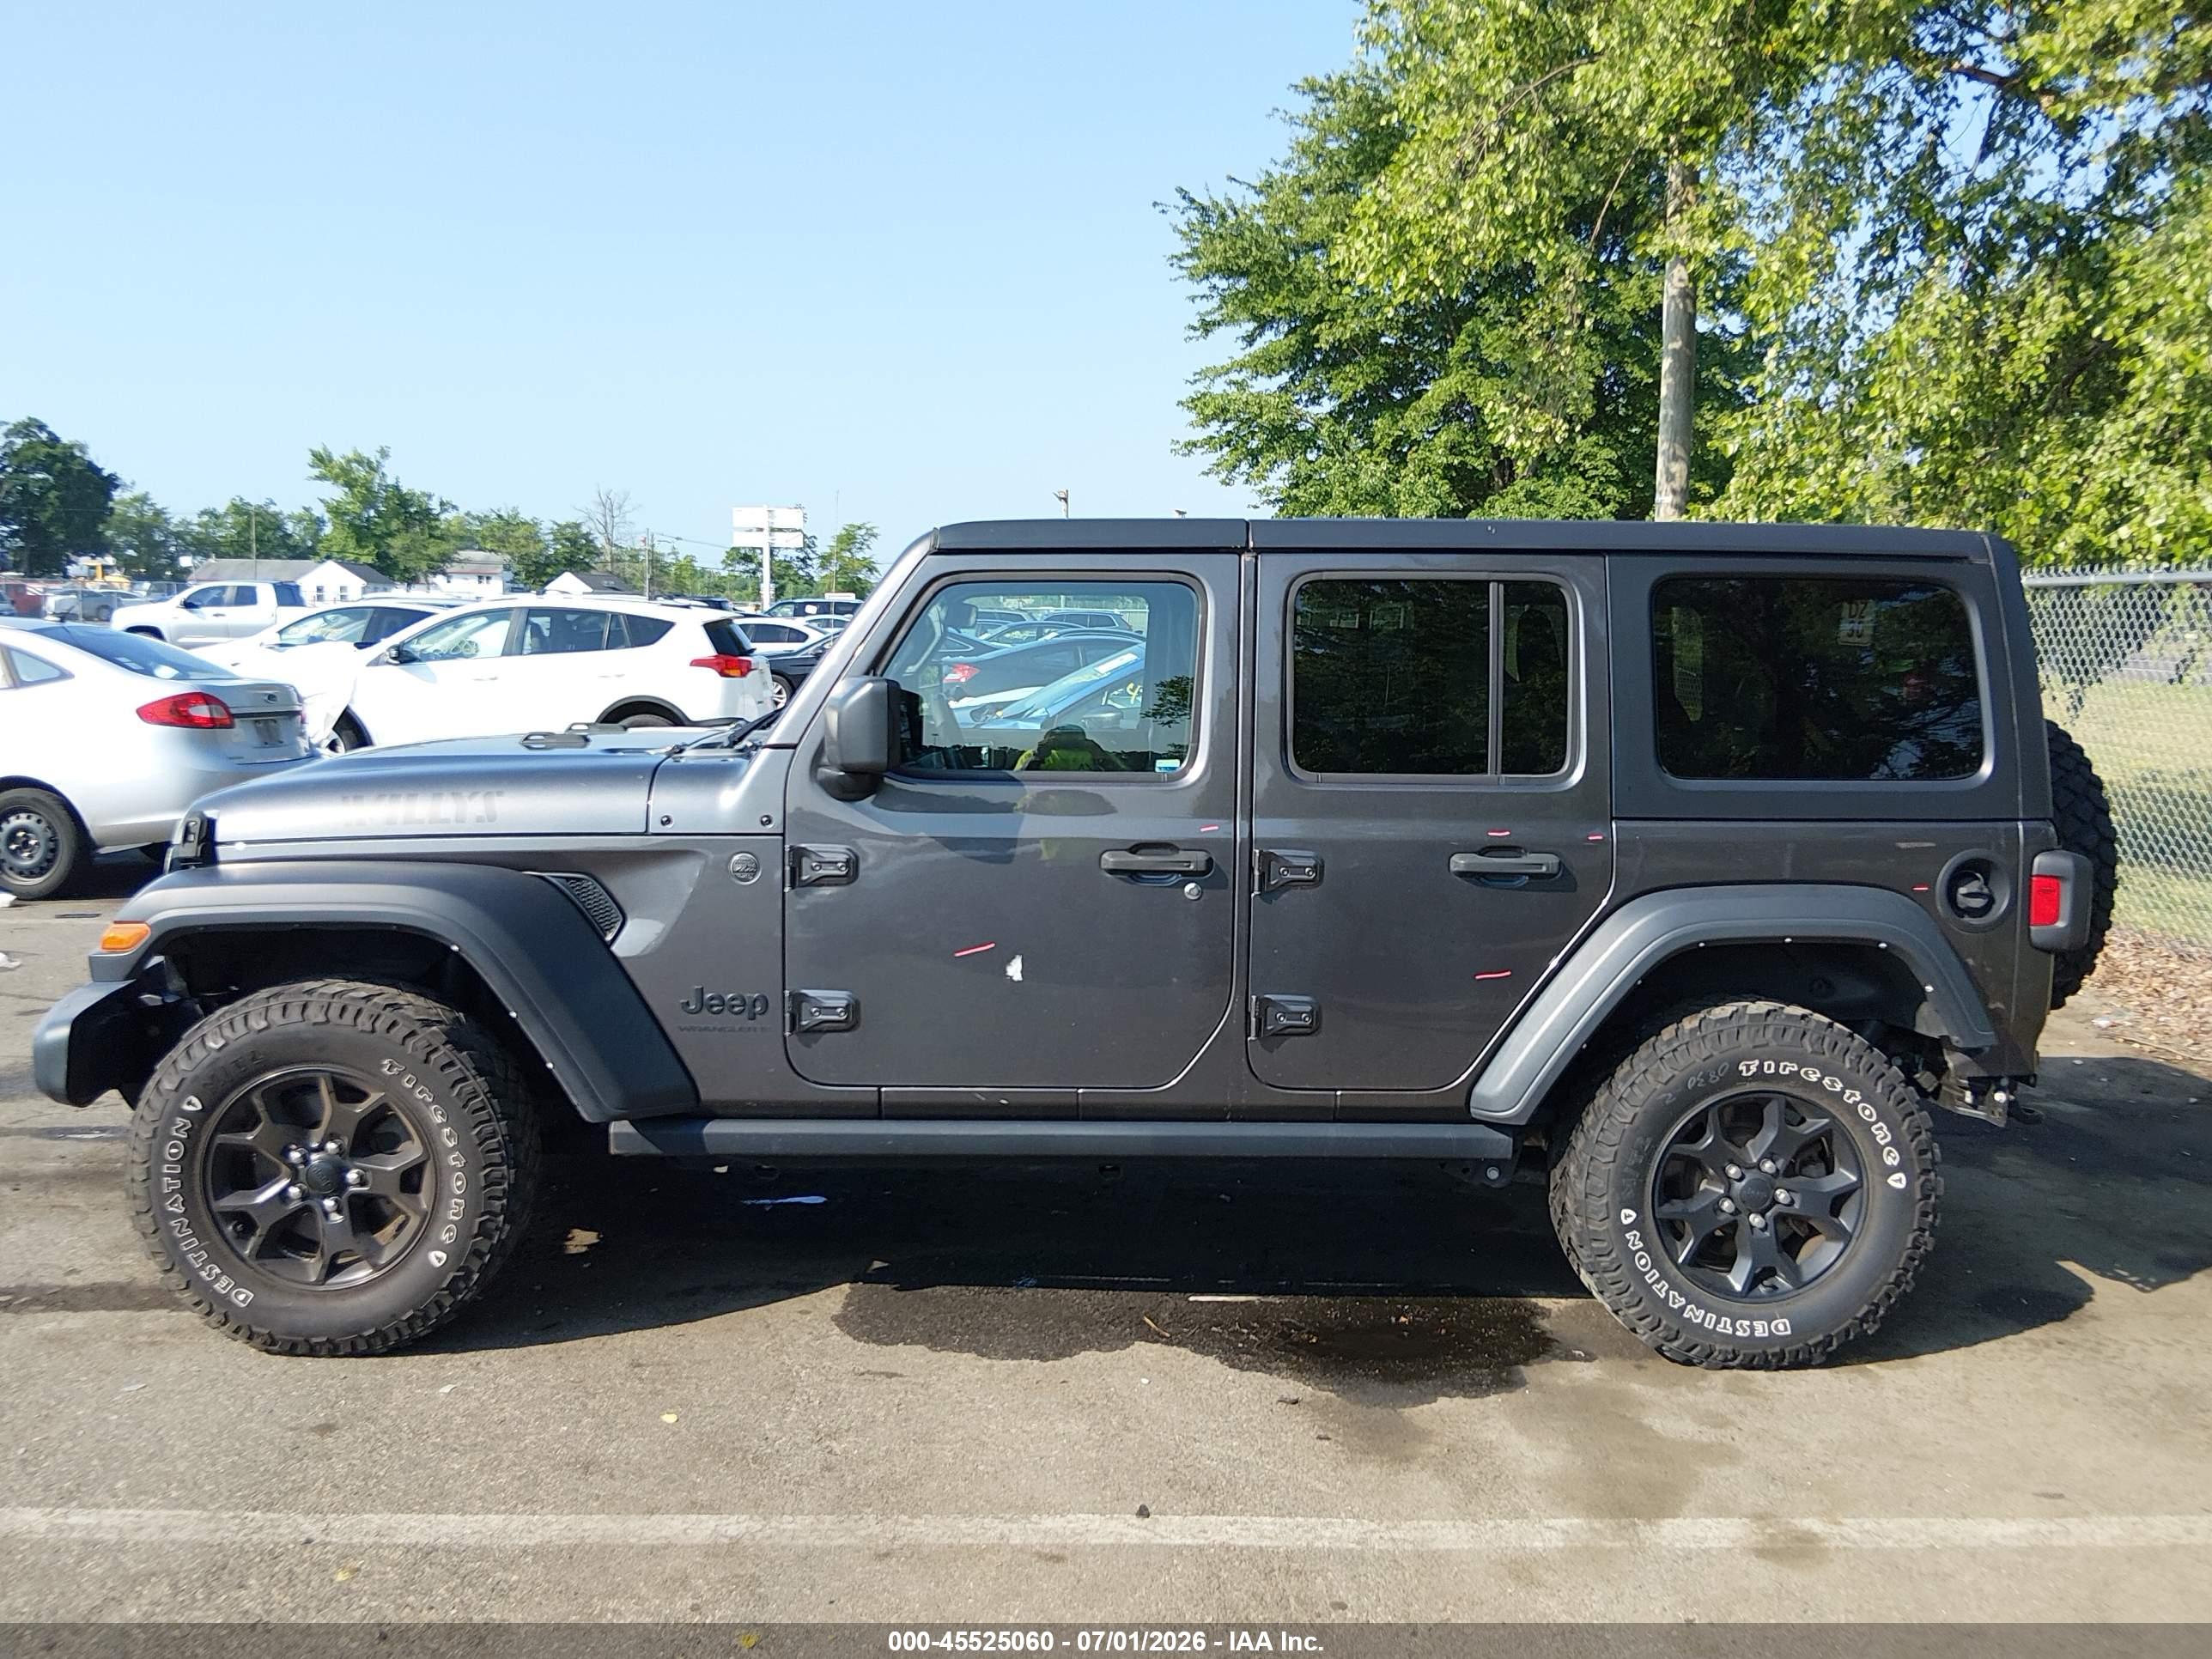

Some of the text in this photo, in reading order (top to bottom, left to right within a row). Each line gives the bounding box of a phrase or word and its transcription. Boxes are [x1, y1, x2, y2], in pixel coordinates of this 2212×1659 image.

[680, 985, 769, 1020] Jeep
[380, 1057, 467, 1245] Firestone
[1739, 1059, 1900, 1166] Firestone
[162, 1118, 255, 1309] DESTINATION
[1624, 1231, 1793, 1337] DESTINATION
